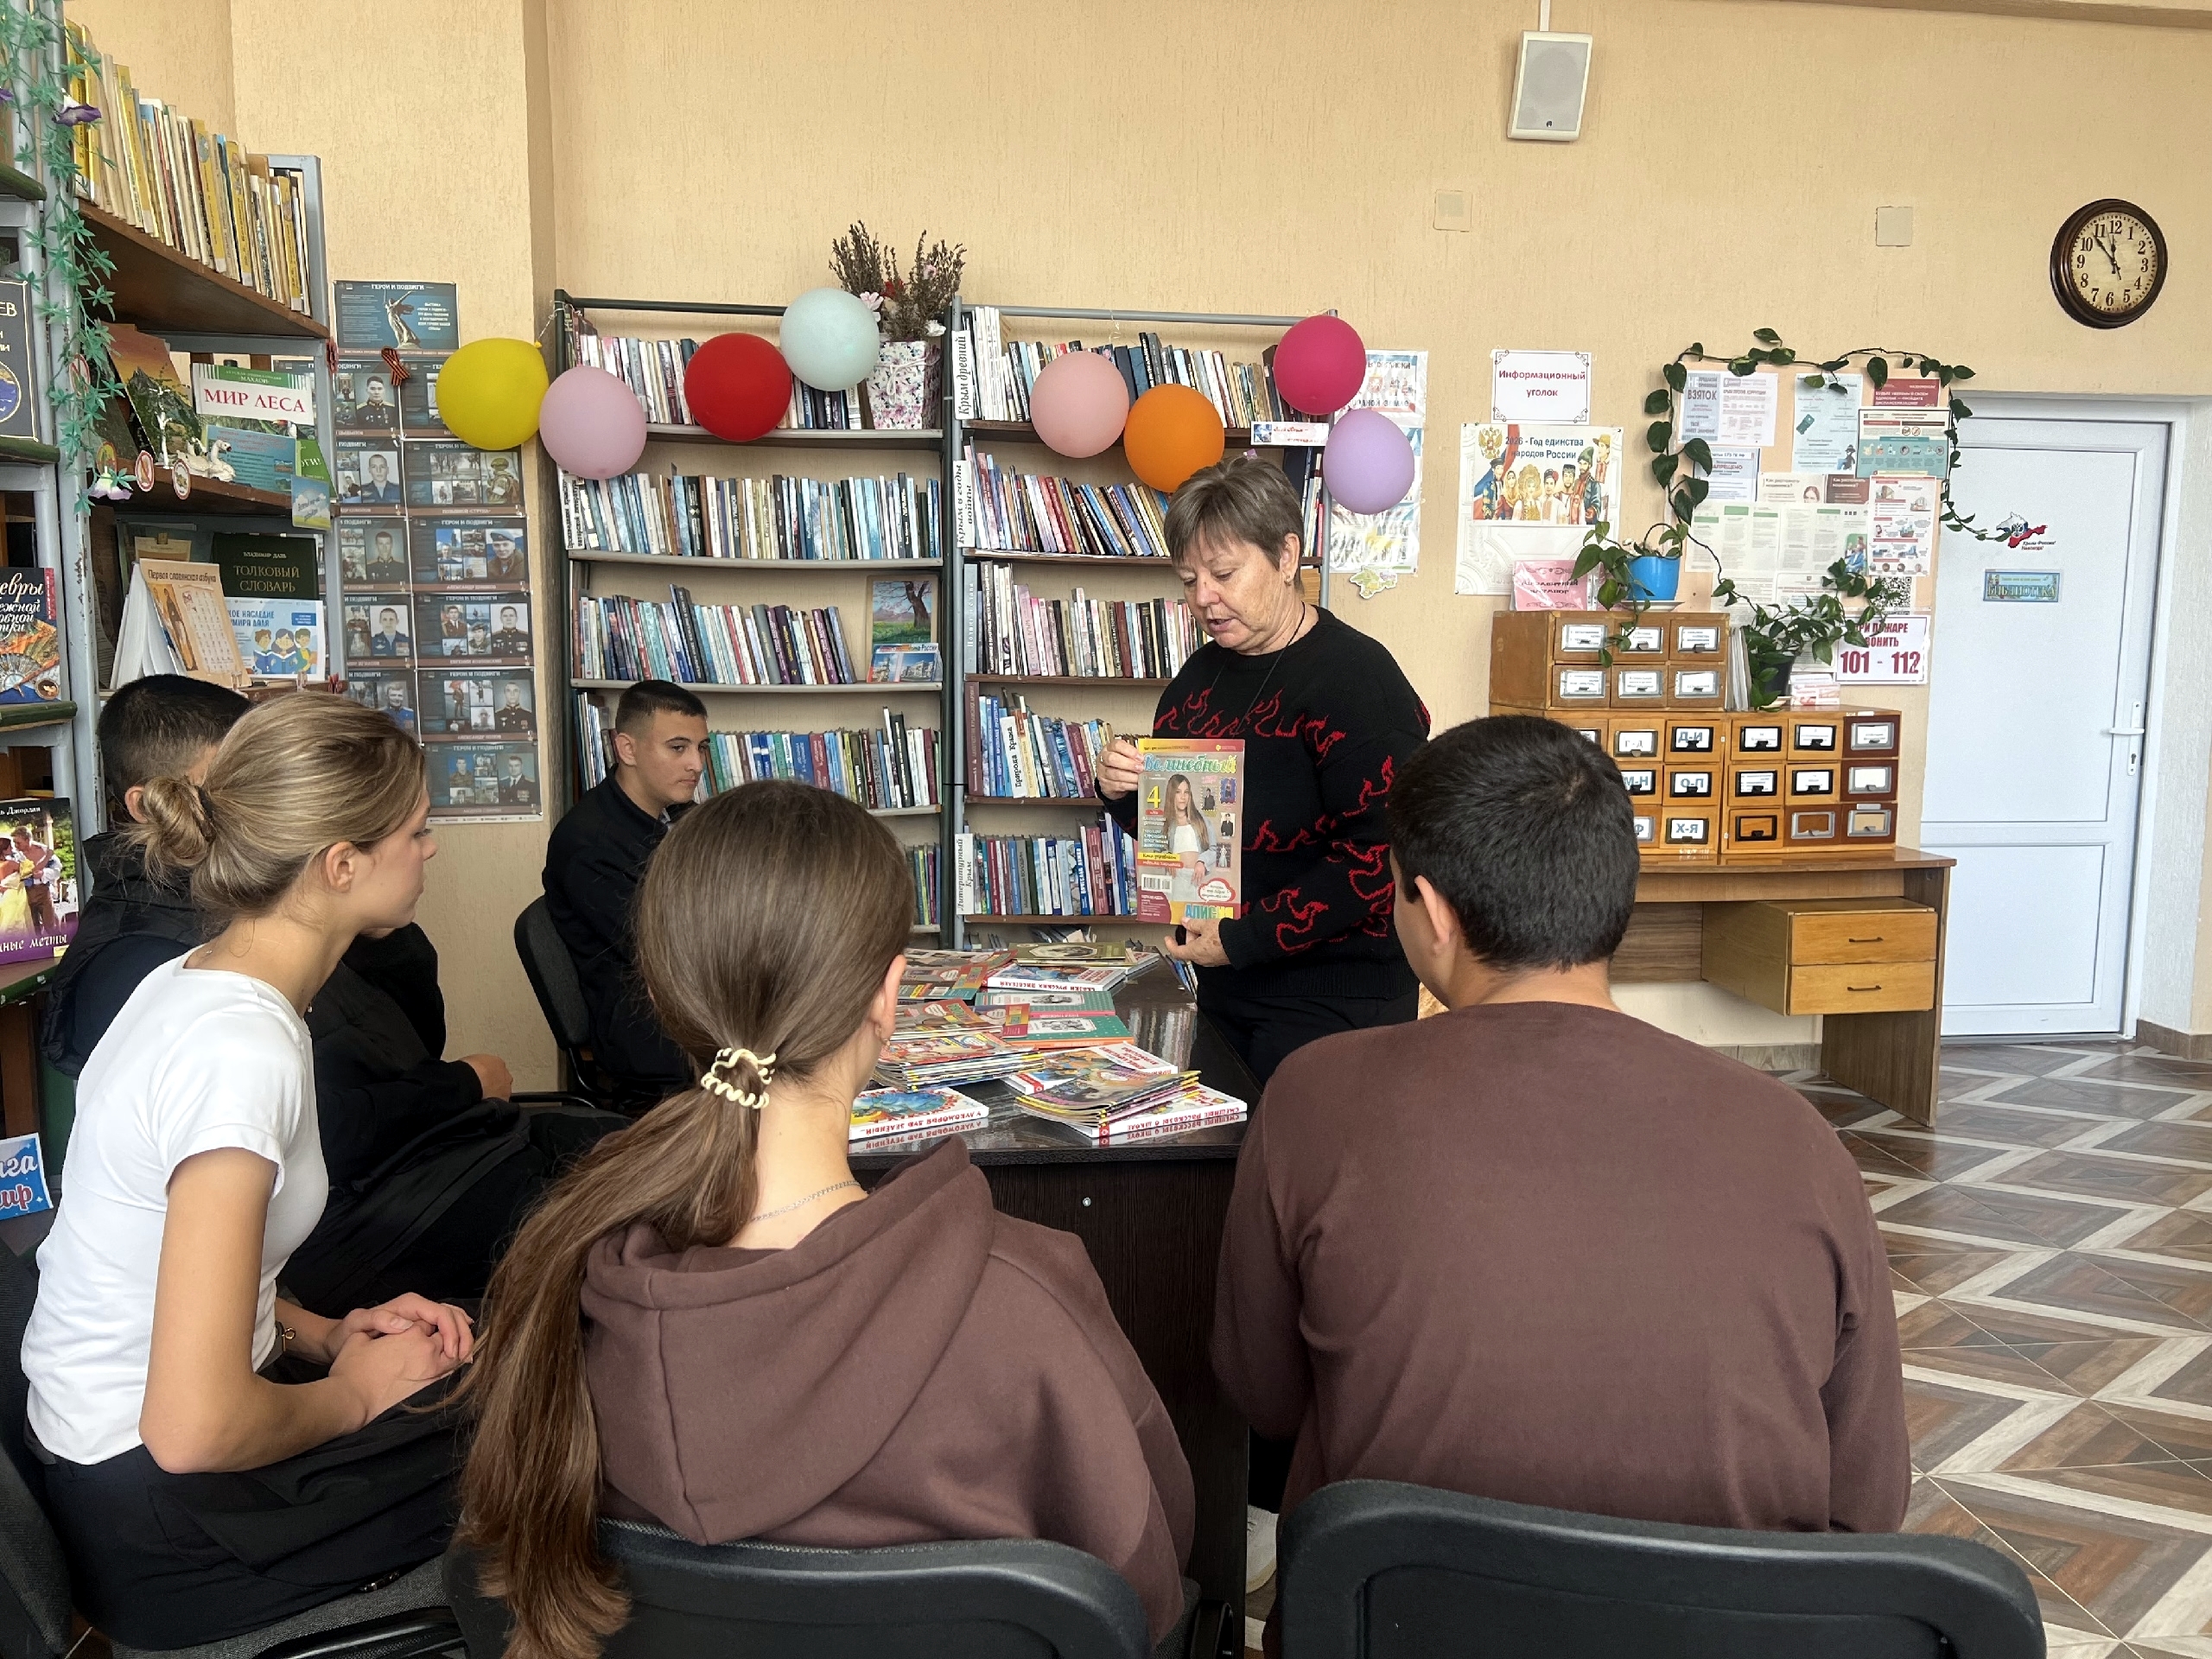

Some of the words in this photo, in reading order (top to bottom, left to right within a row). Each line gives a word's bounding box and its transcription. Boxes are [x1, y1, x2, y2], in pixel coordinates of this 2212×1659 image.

[2094, 223, 2106, 238] 11
[2109, 219, 2122, 234] 12
[2127, 226, 2134, 240] 1
[2080, 237, 2094, 251] 10
[2138, 240, 2146, 255] 2
[2076, 254, 2085, 269] 9
[2140, 257, 2149, 272] 3
[2080, 272, 2088, 288] 8
[2133, 276, 2142, 290] 4
[2091, 288, 2100, 302] 7
[2106, 291, 2114, 307] 6
[2123, 289, 2131, 303] 5
[955, 335, 971, 381] древний
[1498, 370, 1586, 381] Информационный
[957, 383, 971, 416] Крым
[1526, 389, 1558, 397] уголок
[1687, 390, 1717, 400] ВЗЯТОК
[204, 389, 249, 406] МИР
[255, 394, 305, 412] ЛЕСА
[1529, 437, 1543, 447] Год
[1545, 437, 1584, 447] единства
[1511, 450, 1544, 461] народов
[1546, 449, 1577, 459] России
[954, 464, 963, 495] годы
[957, 507, 965, 544] Крым
[232, 564, 301, 579] ТОЛКОВЫЙ
[239, 580, 296, 593] СЛОВАРЬ
[1872, 623, 1909, 632] ПЖАРЕ
[1866, 637, 1899, 647] ВОНИТЬ
[1840, 651, 1870, 674] 101
[1891, 651, 1921, 674] 112
[1006, 726, 1016, 751] Крыма
[1678, 731, 1703, 743] Д-И
[1011, 754, 1022, 787] Природа
[1624, 776, 1649, 786] М-Н
[1680, 778, 1704, 789] О-П
[1147, 785, 1161, 809] 4
[1675, 823, 1699, 834] Х-Я
[956, 838, 965, 912] Литературный
[965, 861, 974, 887] Крым
[1162, 1112, 1202, 1125] РАССКАЗЫ
[1204, 1107, 1240, 1119] СМЕШНЫЕ
[1127, 1122, 1153, 1131] ШКОЛЕ
